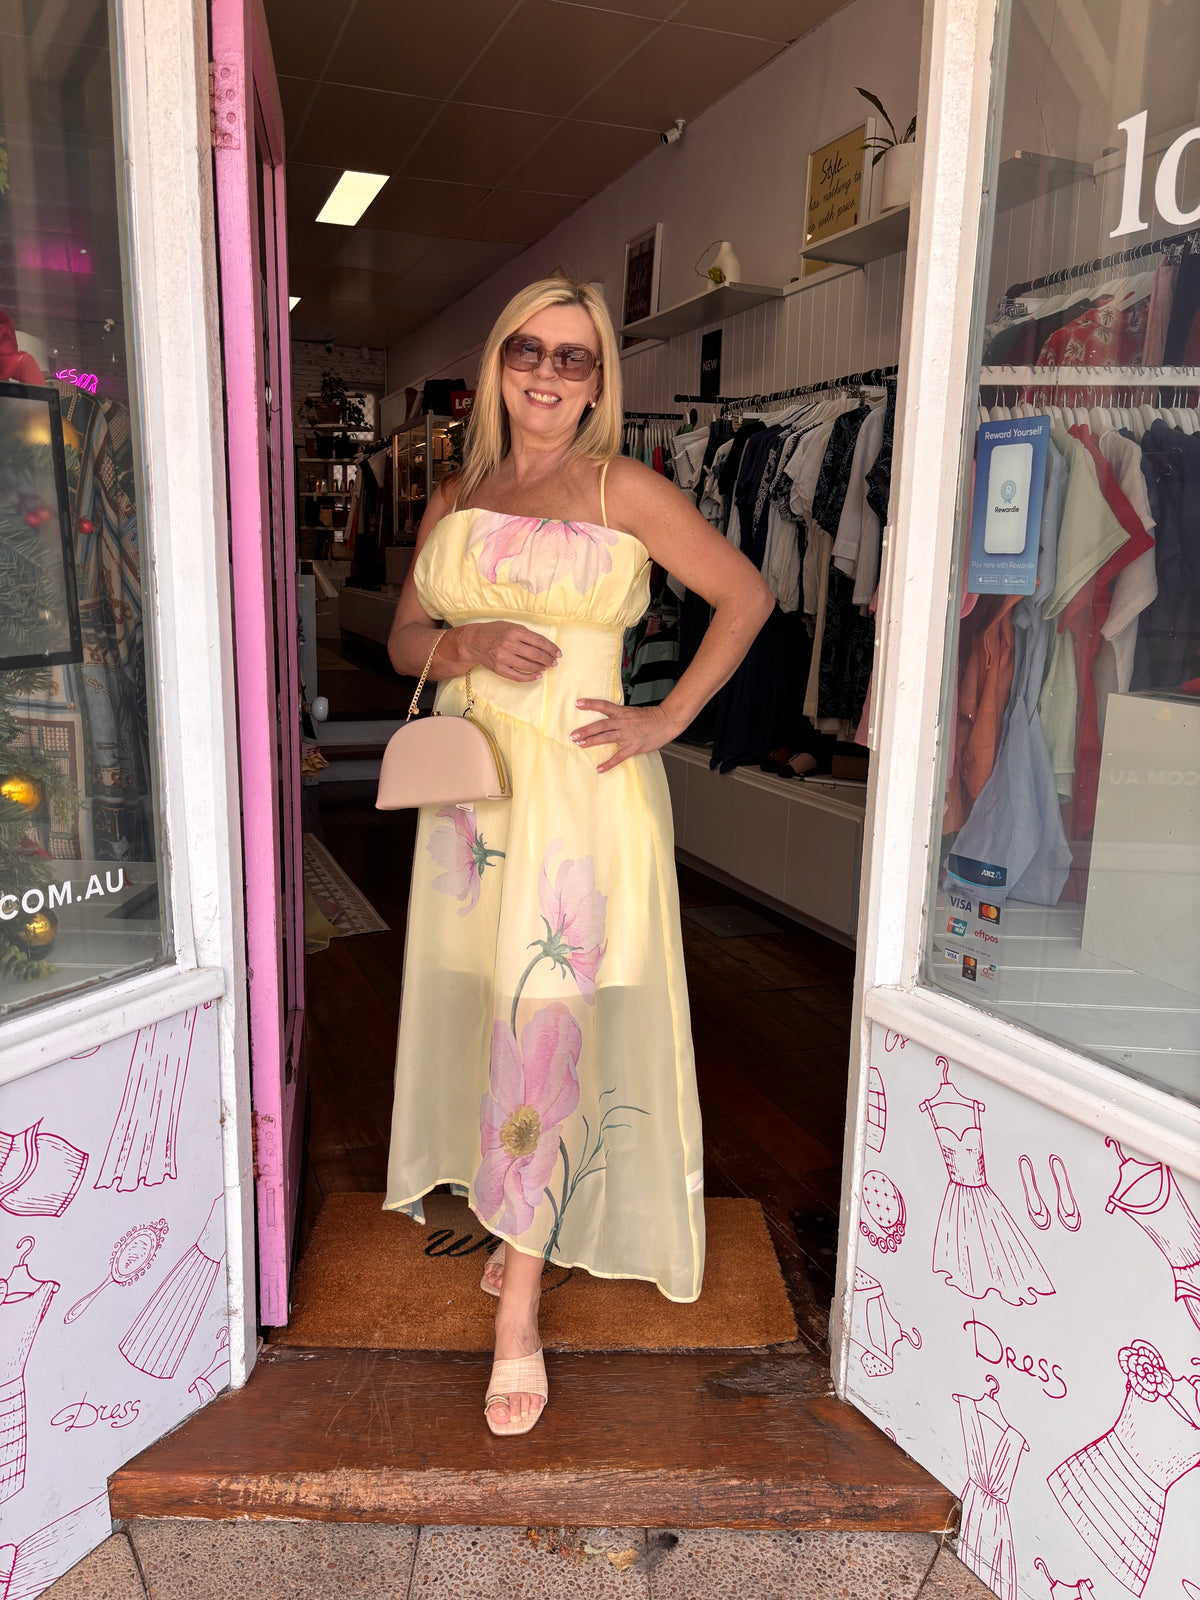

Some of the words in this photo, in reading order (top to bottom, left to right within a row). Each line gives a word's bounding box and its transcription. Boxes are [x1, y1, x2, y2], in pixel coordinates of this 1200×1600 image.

[823, 178, 852, 203] nothing
[817, 203, 834, 228] with
[702, 357, 718, 372] NEW
[984, 429, 1012, 440] Reward
[1013, 425, 1043, 437] Yourself
[994, 505, 1020, 513] Rewardle
[971, 560, 982, 569] Pay
[983, 560, 996, 568] here
[996, 560, 1008, 568] with
[1008, 560, 1036, 569] Rewardle
[981, 869, 996, 879] ANZ
[0, 868, 124, 920] COM.AU
[950, 895, 972, 912] VISA
[974, 929, 999, 944] eftpos
[50, 1391, 141, 1432] Dress
